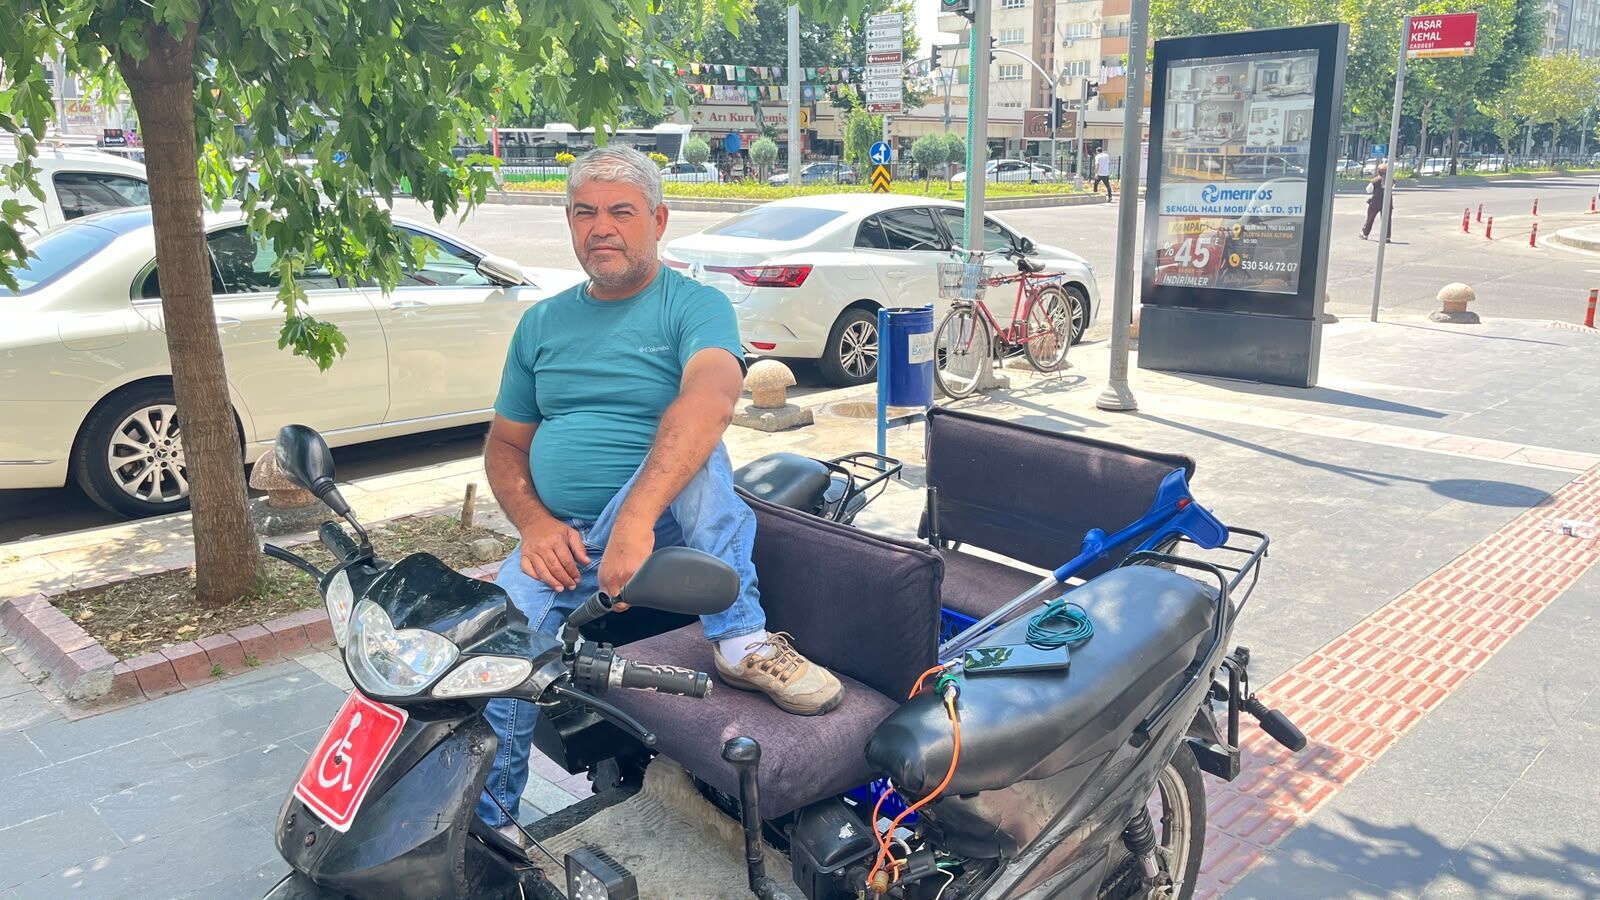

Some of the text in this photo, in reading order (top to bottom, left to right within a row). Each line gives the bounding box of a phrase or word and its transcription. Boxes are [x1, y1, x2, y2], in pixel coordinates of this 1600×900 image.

[1412, 20, 1442, 30] YAŞAR
[1411, 32, 1442, 42] KEMAL
[709, 112, 788, 124] Arı Kuruemiş
[1166, 205, 1199, 213] ŞENGÜL
[1201, 205, 1221, 213] HALI
[1223, 204, 1263, 213] MOBİYA
[1287, 205, 1302, 214] ŞTİ
[1241, 260, 1298, 272] 530 546 72 07
[1163, 274, 1209, 286] İNDİRİMLER
